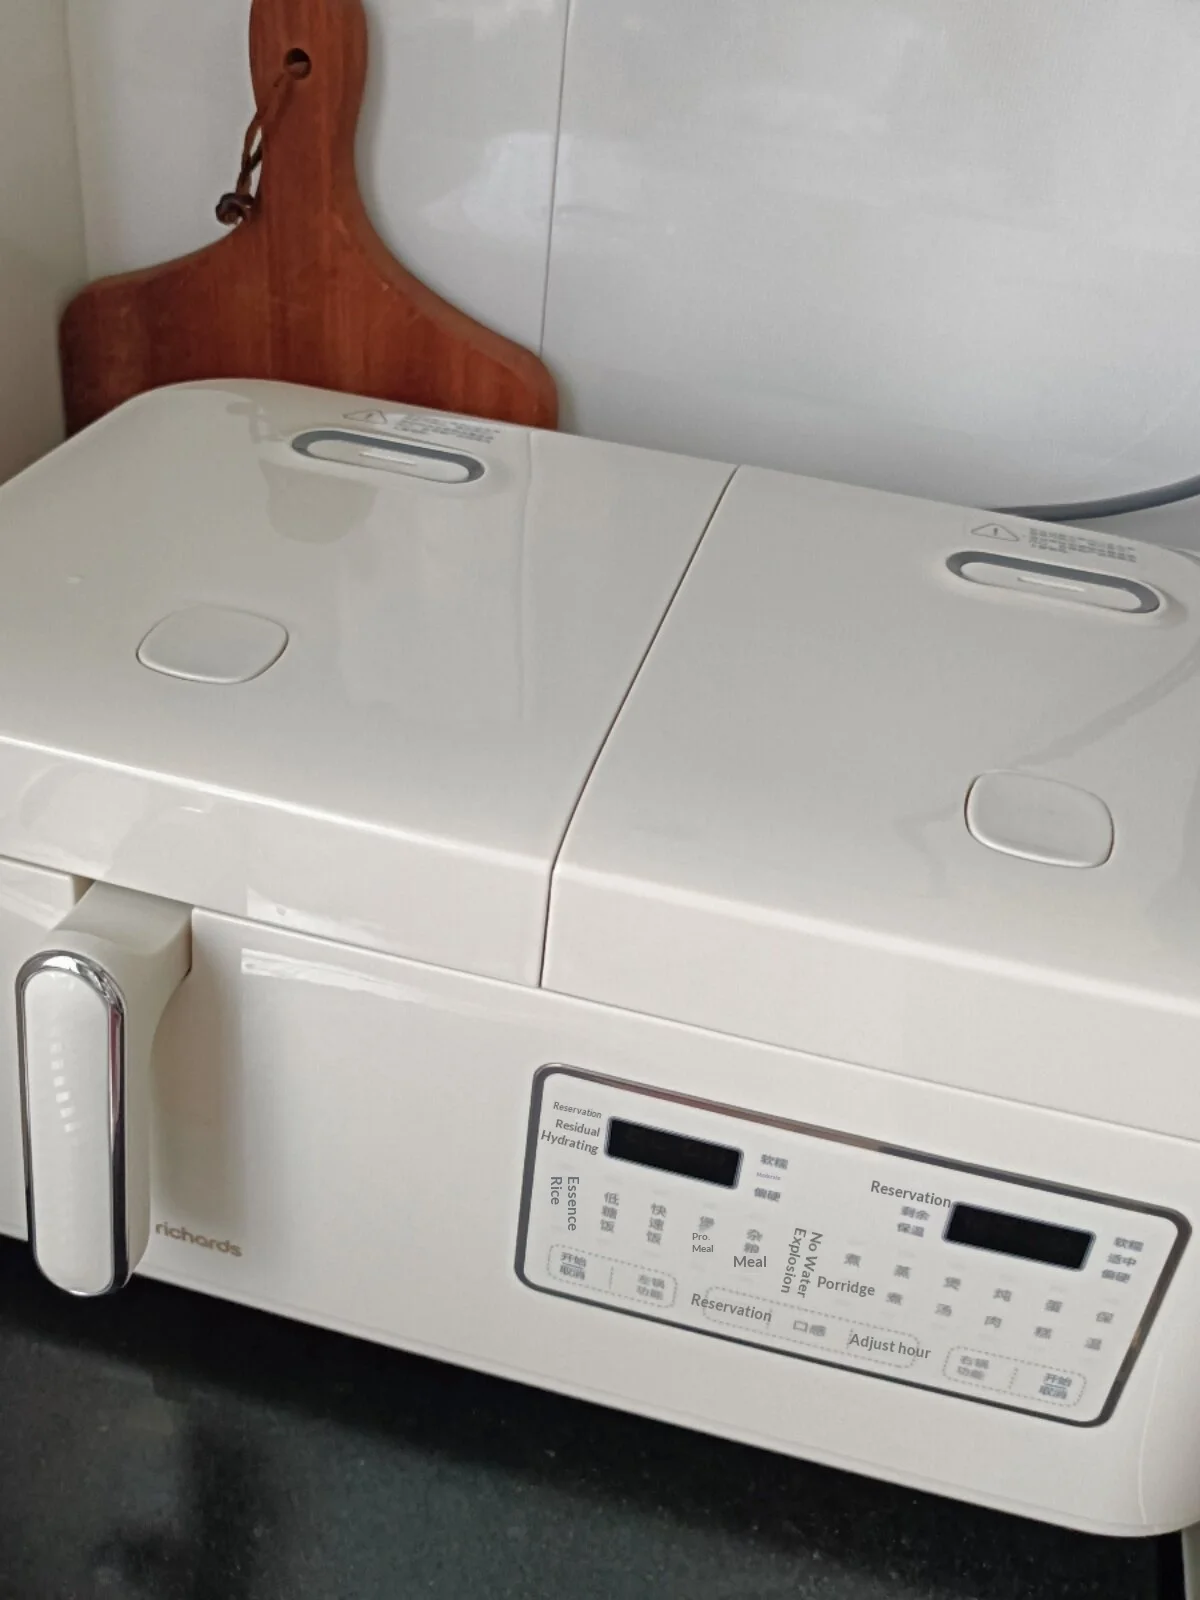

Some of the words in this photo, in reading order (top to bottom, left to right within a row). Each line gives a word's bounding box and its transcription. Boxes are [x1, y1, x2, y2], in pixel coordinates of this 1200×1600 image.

[553, 1101, 602, 1119] Reservation
[555, 1118, 601, 1137] Residual
[540, 1129, 599, 1156] Hydrating
[550, 1176, 563, 1205] Rice
[567, 1176, 580, 1231] Essence
[870, 1180, 952, 1208] Reservation
[155, 1221, 242, 1257] richards
[692, 1232, 711, 1242] Pro.
[692, 1244, 714, 1254] Meal
[808, 1231, 824, 1253] No
[733, 1255, 767, 1269] Meal
[780, 1227, 807, 1294] Explosion
[797, 1255, 818, 1299] Water
[816, 1275, 876, 1298] Porridge
[690, 1293, 773, 1323] Reservation
[849, 1333, 896, 1354] Adjust
[897, 1341, 932, 1359] hour
